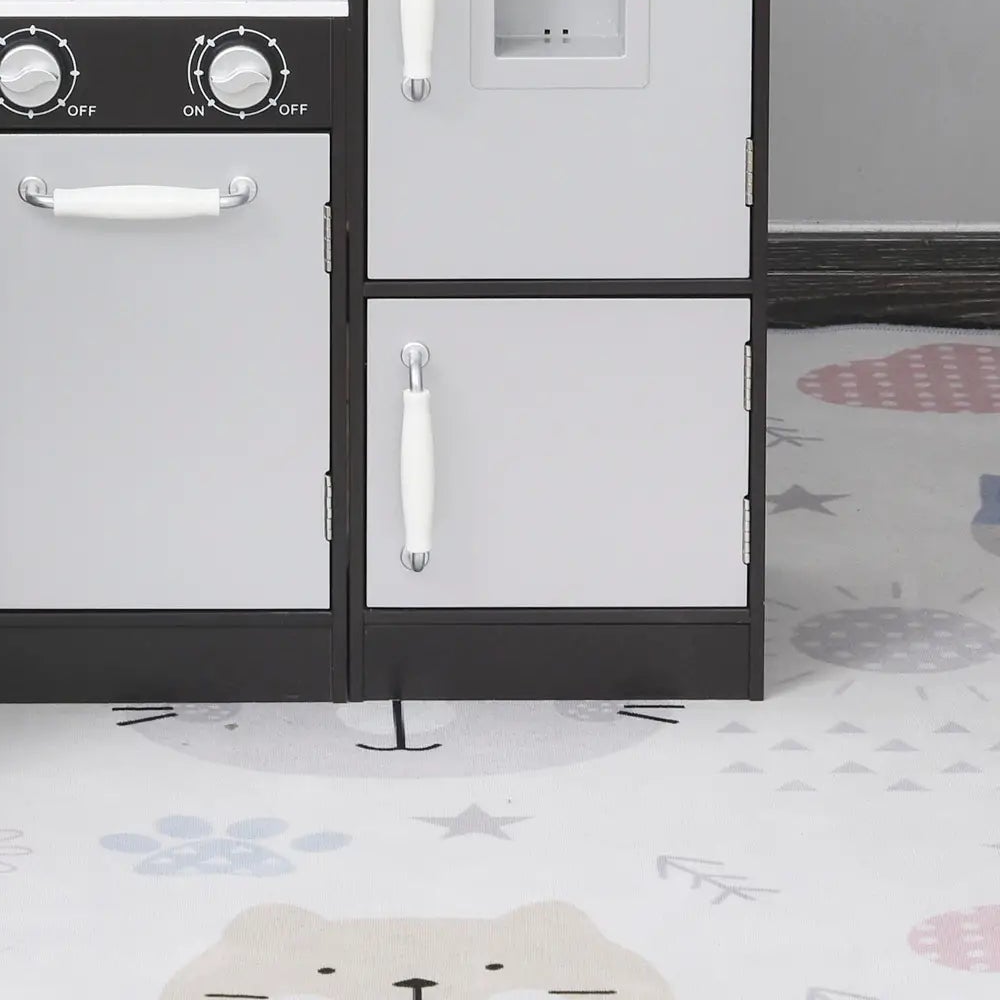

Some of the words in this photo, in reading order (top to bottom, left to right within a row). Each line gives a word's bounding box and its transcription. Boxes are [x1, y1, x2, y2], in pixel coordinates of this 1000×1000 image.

[67, 104, 97, 117] OFF
[183, 104, 205, 117] ON
[279, 103, 308, 116] OFF
